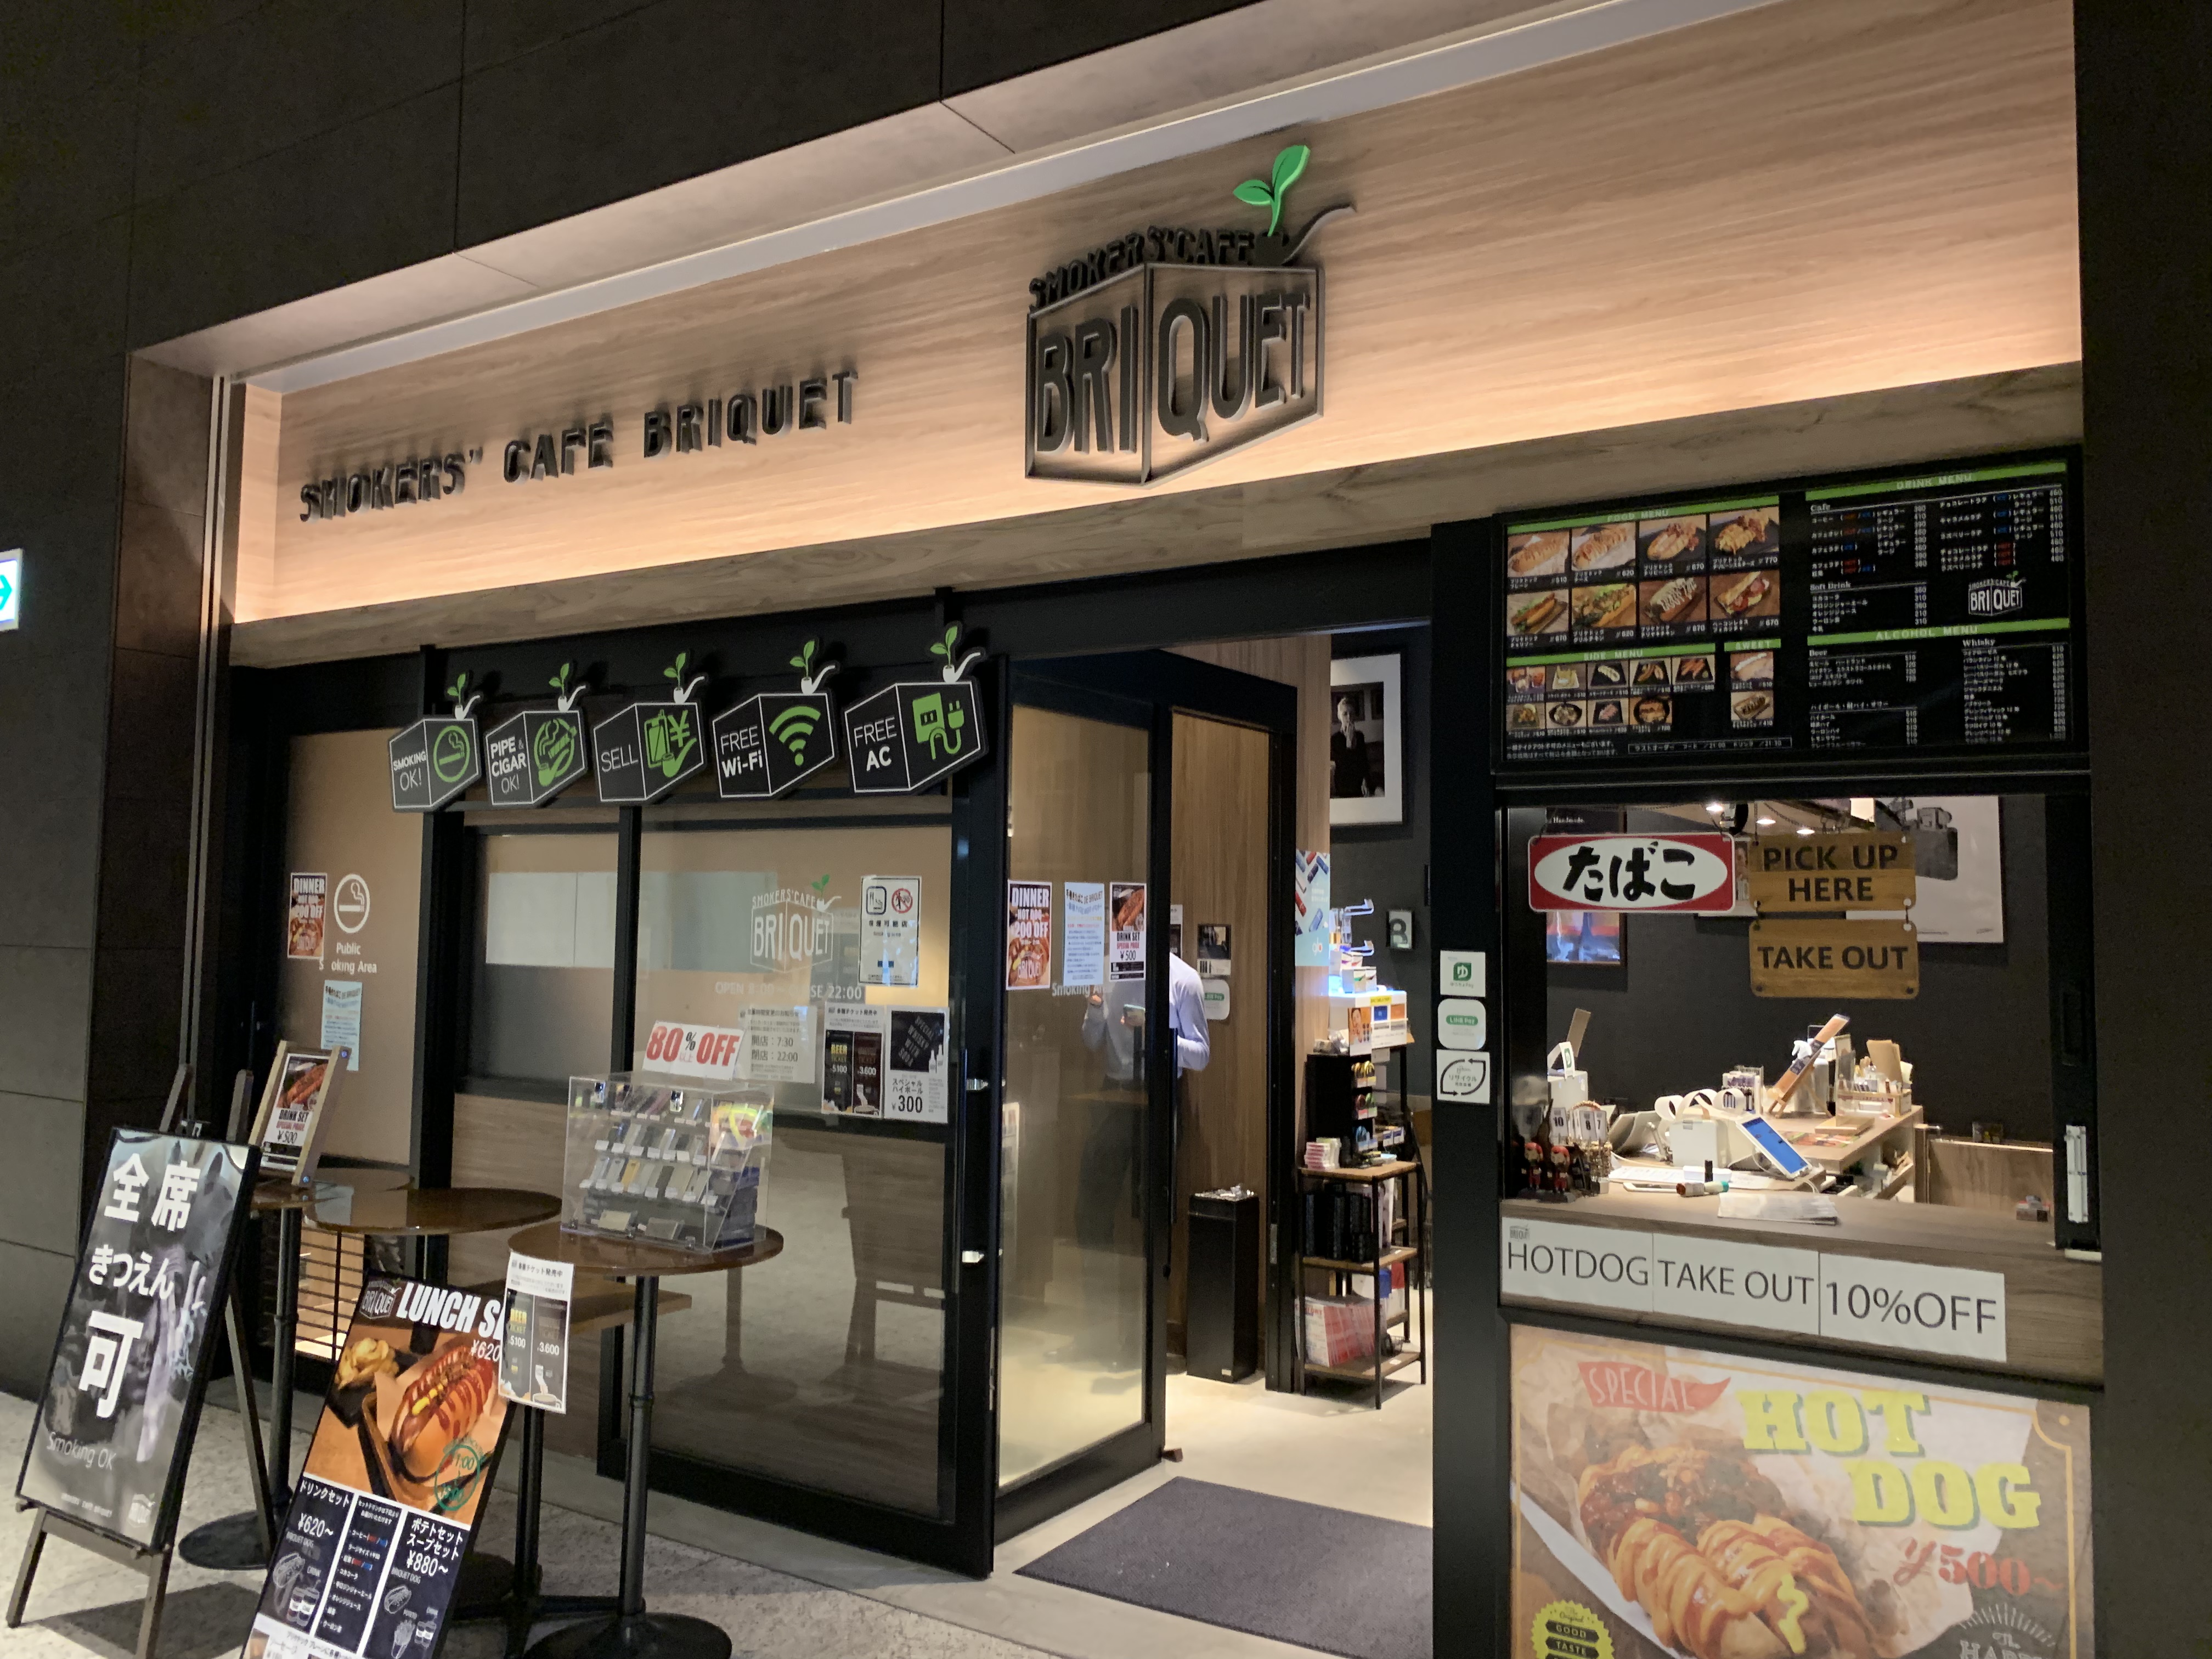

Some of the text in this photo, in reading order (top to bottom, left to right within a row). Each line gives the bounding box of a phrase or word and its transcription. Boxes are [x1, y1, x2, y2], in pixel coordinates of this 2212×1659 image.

[1036, 293, 1311, 454] BRIQUET
[504, 419, 614, 484] CAFE
[644, 371, 859, 459] BRIQUET
[1897, 475, 1972, 489] DRINK MENU
[1607, 509, 1669, 521] FOOD MENU
[1810, 503, 1831, 511] Cafe
[1827, 580, 1851, 589] Drink
[1970, 589, 2020, 612] BRIQUET
[1876, 625, 1978, 640] ALCOHOL MENU
[1962, 639, 1995, 647] Whisky
[1584, 650, 1643, 661] SIDE MENU
[1736, 640, 1770, 650] SWEET
[721, 726, 760, 755] FREE
[854, 715, 897, 748] FREE
[490, 736, 516, 759] PIPE
[601, 746, 639, 772] SELL
[866, 747, 892, 771] AC
[393, 751, 427, 771] SMOKING
[492, 753, 527, 777] CIGAR
[721, 750, 763, 778] Wi-Fi
[399, 768, 422, 791] OK!
[501, 774, 520, 794] OK!
[1763, 845, 1898, 871] PICK UP
[1563, 842, 1695, 901] たばこ
[294, 878, 325, 894] DINNER
[1012, 887, 1049, 907] DINNER
[1788, 878, 1873, 901] HERE
[754, 912, 830, 961] BRIQUET
[1117, 932, 1140, 942] DRINK SET
[336, 943, 361, 955] Public
[1120, 950, 1136, 961] ¥500
[1757, 946, 1908, 970] TAKE OUT
[319, 959, 377, 974] Soking Area
[827, 986, 862, 1000] 22:00
[831, 1043, 848, 1054] BEER
[1449, 1074, 1477, 1082] リサイクル
[892, 1087, 924, 1095] ハイボール
[279, 1109, 309, 1123] DRINK SET
[104, 1153, 201, 1232] 全席
[88, 1244, 175, 1300] きつえん
[1507, 1242, 1649, 1286] HOTDOG
[1657, 1259, 1735, 1297] TAKE
[1743, 1270, 1815, 1305] OUT
[362, 1290, 394, 1316] BRIQUET
[396, 1282, 482, 1333] LUNCH
[510, 1308, 527, 1324] BEER
[78, 1310, 144, 1419] 可
[1590, 1365, 1696, 1411] SPECIAL
[1736, 1389, 1931, 1457] HOT
[47, 1431, 116, 1470] Smoking OK
[299, 1480, 350, 1508] ドリンクセット
[1843, 1459, 2041, 1530] DOG
[411, 1517, 464, 1545] ポテトセット
[406, 1533, 459, 1561] スープセット
[1556, 1624, 1587, 1638] GOOD
[1556, 1641, 1587, 1655] TASTE
